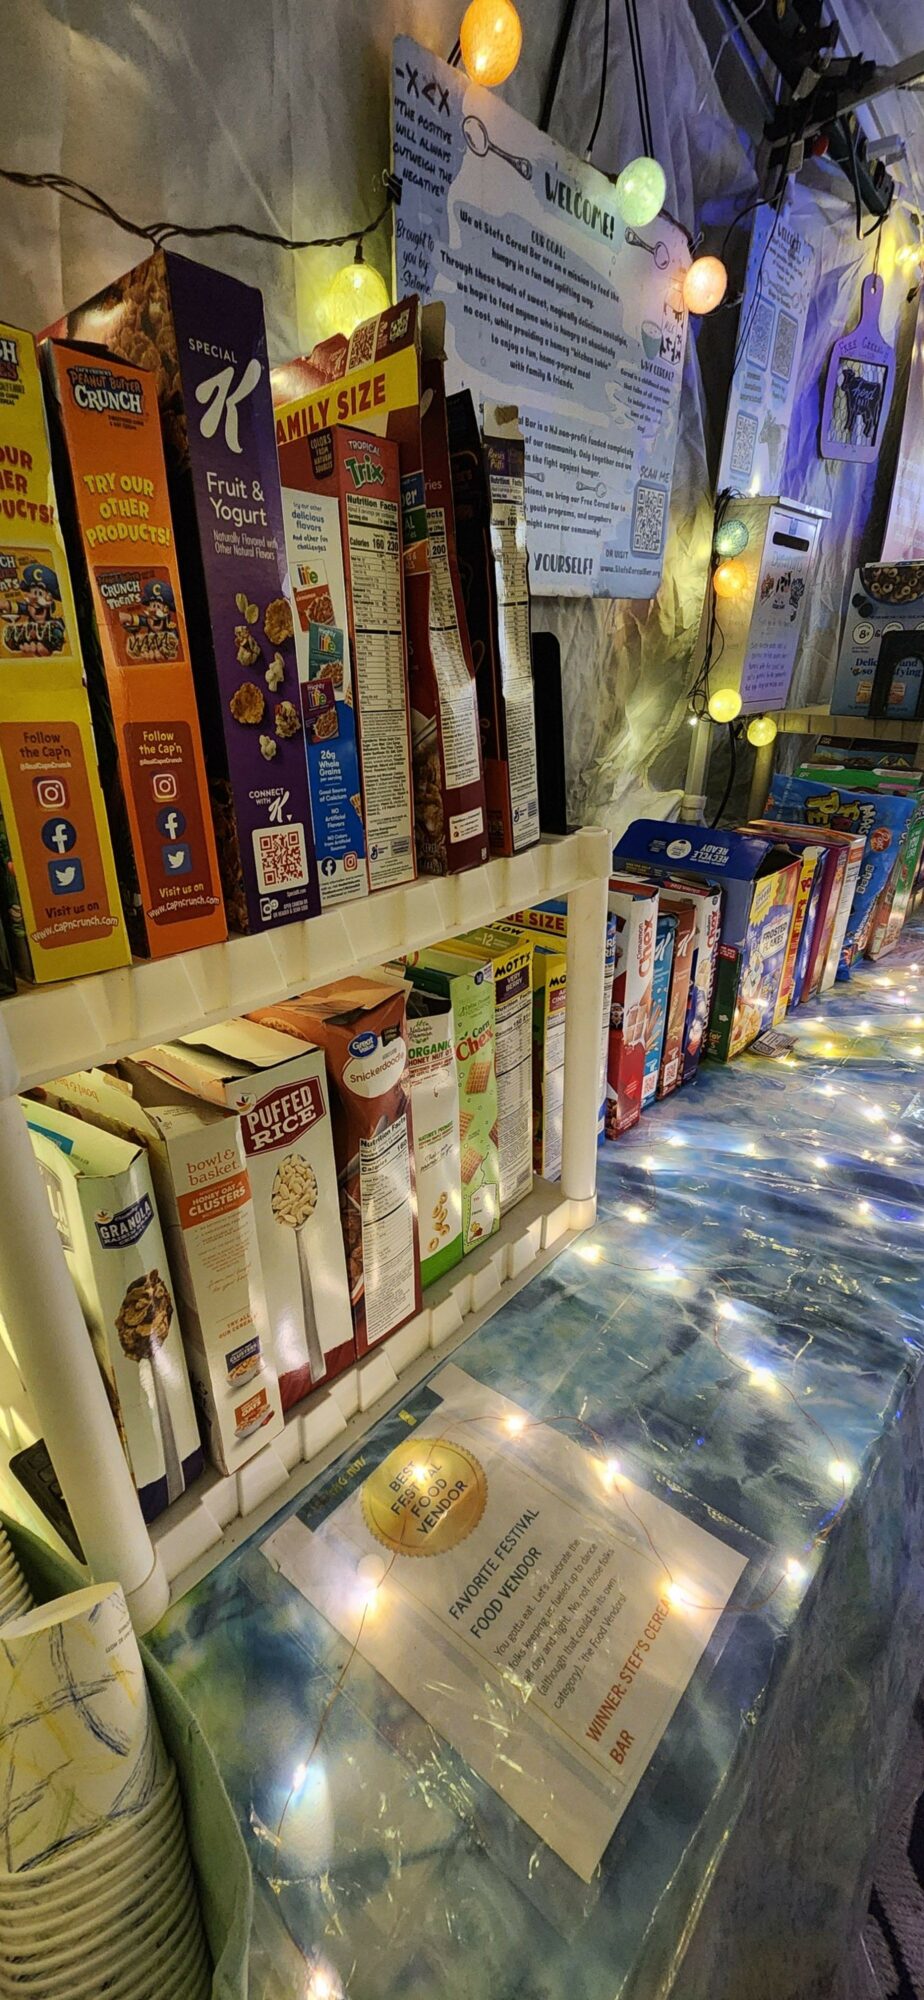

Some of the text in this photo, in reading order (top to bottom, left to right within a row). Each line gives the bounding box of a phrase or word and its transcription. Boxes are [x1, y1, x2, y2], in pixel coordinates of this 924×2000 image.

[418, 115, 452, 144] POSITIVE
[395, 122, 451, 163] WILL ALWAYS
[393, 142, 452, 184] OUTWEIGH THE
[545, 171, 615, 240] WELCOME!
[395, 218, 427, 250] Brought
[492, 247, 516, 271] hungry
[505, 234, 541, 261] Cereal Bar
[402, 250, 416, 269] you
[440, 250, 577, 325] Through these bowls magically
[469, 284, 580, 344] hope feed anyone hungry
[494, 316, 544, 346] while providing
[189, 338, 238, 364] SPECIAL
[500, 338, 577, 374] enjoy home-poured
[69, 370, 107, 388] PEANUT
[109, 376, 141, 392] BUTTER
[525, 364, 545, 382] family
[74, 384, 142, 413] CRUNCH
[195, 358, 261, 453] K
[276, 372, 386, 445] AMILY SIZE
[310, 434, 331, 449] COLORS
[348, 440, 380, 456] TROPICAL
[558, 429, 607, 449] non-profit funded
[344, 453, 385, 488] Trix
[543, 456, 580, 473] fight against
[83, 472, 154, 498] TRY OUR
[206, 471, 265, 502] Fruit &
[659, 472, 670, 484] ME
[99, 497, 150, 519] OTHER
[347, 494, 397, 512] Nutrition Facts
[555, 491, 569, 504] bring
[210, 497, 267, 527] Yogurt
[291, 510, 325, 524] delicious
[86, 522, 171, 548] PRODUCTS!
[296, 520, 322, 532] flavors
[213, 529, 266, 548] Naturally Flavored
[350, 537, 399, 552] Calories 160 230
[432, 544, 446, 555] 200
[214, 541, 275, 560] Other Natural Flavors
[533, 552, 593, 575] YOURSELF!
[298, 565, 318, 586] life
[100, 580, 140, 597] CRUNCH
[106, 593, 141, 609] TREATS
[23, 731, 60, 745] Follow
[142, 730, 174, 741] Follow
[20, 745, 71, 762] the Cap'n
[139, 743, 183, 756] the Cap'n
[320, 750, 336, 760] 26g
[318, 760, 340, 768] Whole
[319, 768, 341, 777] Grains
[249, 788, 284, 799] CONNECT
[256, 798, 271, 806] WITH
[692, 850, 730, 864] RECYCLE
[700, 844, 730, 856] READY
[159, 883, 204, 898] Visit us on
[45, 902, 99, 918] Visit us on
[148, 895, 219, 919] www.capncrunch.com
[32, 915, 118, 942] www.capncrunch.com
[529, 913, 565, 930] SIZE
[763, 921, 788, 940] FROSTED
[637, 922, 645, 960] Cinnamon
[638, 916, 654, 979] Chex
[505, 978, 523, 992] BERRY
[506, 971, 521, 983] VERY
[472, 1021, 490, 1038] Corn
[408, 1039, 451, 1059] ORGANIC
[456, 1024, 494, 1061] Chex
[409, 1056, 430, 1066] HONEY
[246, 1085, 312, 1134] PUFFED
[250, 1105, 316, 1150] RICE
[360, 1117, 406, 1148] Nutrition Facts
[186, 1151, 222, 1174] bowl
[188, 1185, 246, 1217] CLUSTERS
[192, 1183, 236, 1206] HONEY OAT
[100, 1201, 151, 1239] GRANOLA
[388, 1460, 415, 1492] BEST
[390, 1463, 442, 1516] FESTAL
[410, 1478, 448, 1518] FOOD
[416, 1480, 469, 1534] VENDOR
[448, 1509, 540, 1621] FAVORITE FESTIVAL
[469, 1546, 542, 1639] FOOD VENDOR
[493, 1539, 580, 1656] You gotta Let's celebrate the
[521, 1617, 550, 1649] keeping
[550, 1582, 571, 1608] fueled
[569, 1572, 579, 1585] up
[581, 1543, 598, 1566] dance
[531, 1549, 615, 1671] day and not those folks
[537, 1577, 617, 1696] (although that could own
[590, 1627, 608, 1649] Food
[585, 1683, 627, 1742] WINNER:
[619, 1639, 650, 1685] STEF'S
[609, 1729, 635, 1765] BAR
